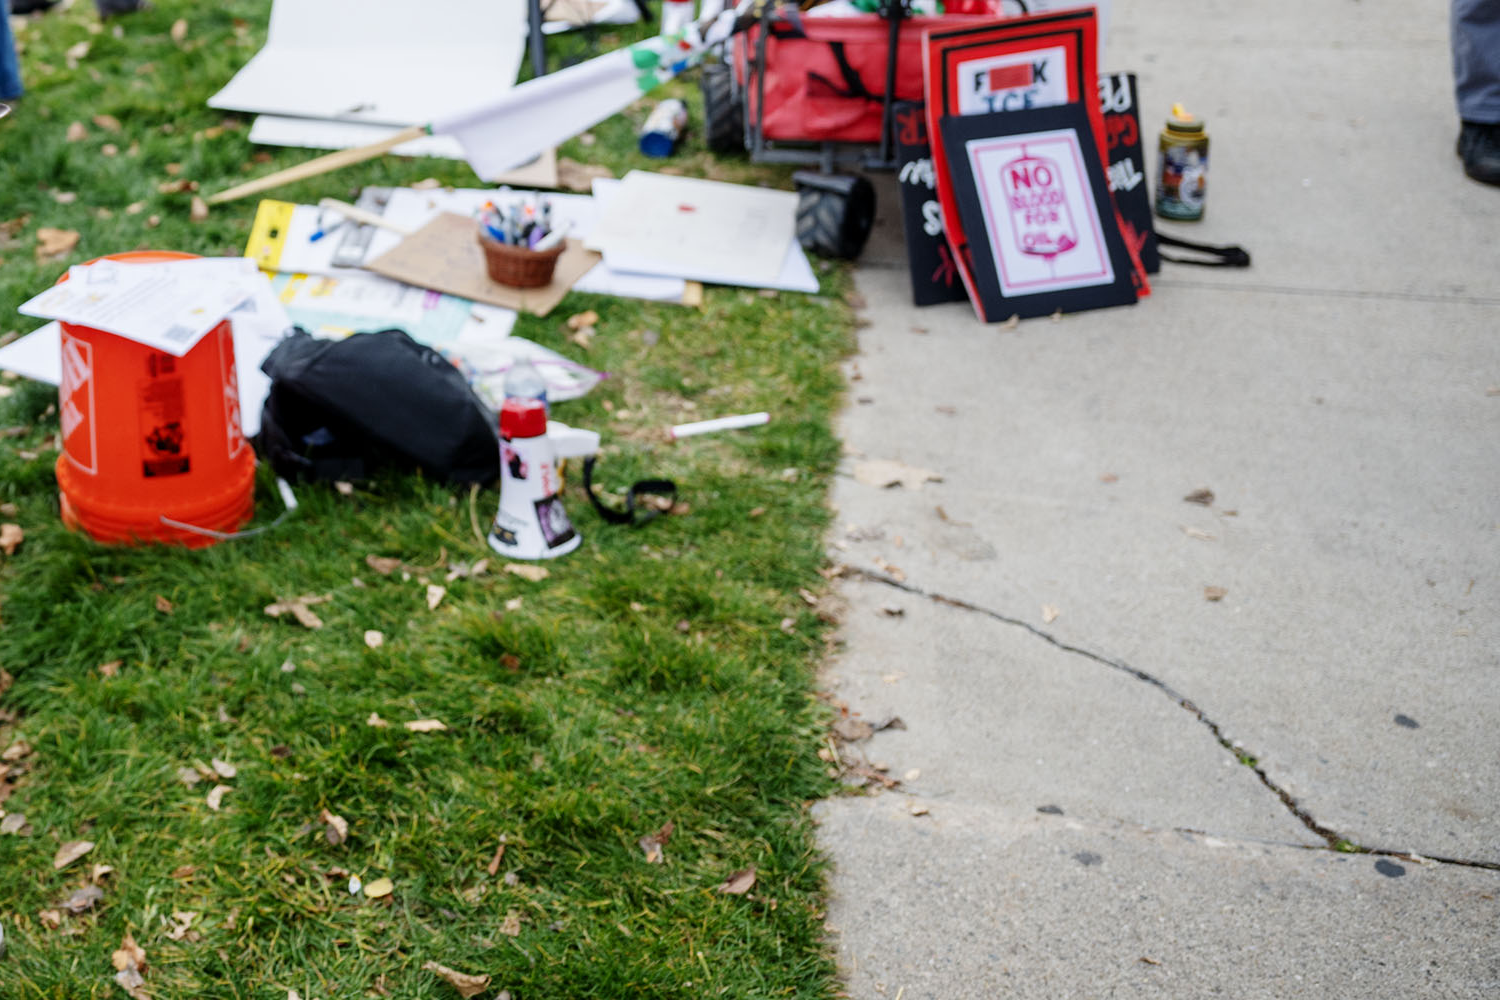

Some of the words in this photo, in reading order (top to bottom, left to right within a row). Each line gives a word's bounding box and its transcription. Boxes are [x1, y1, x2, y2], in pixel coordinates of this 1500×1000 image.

[973, 60, 1050, 92] FK
[1009, 166, 1053, 190] NO
[1024, 211, 1059, 226] FOR
